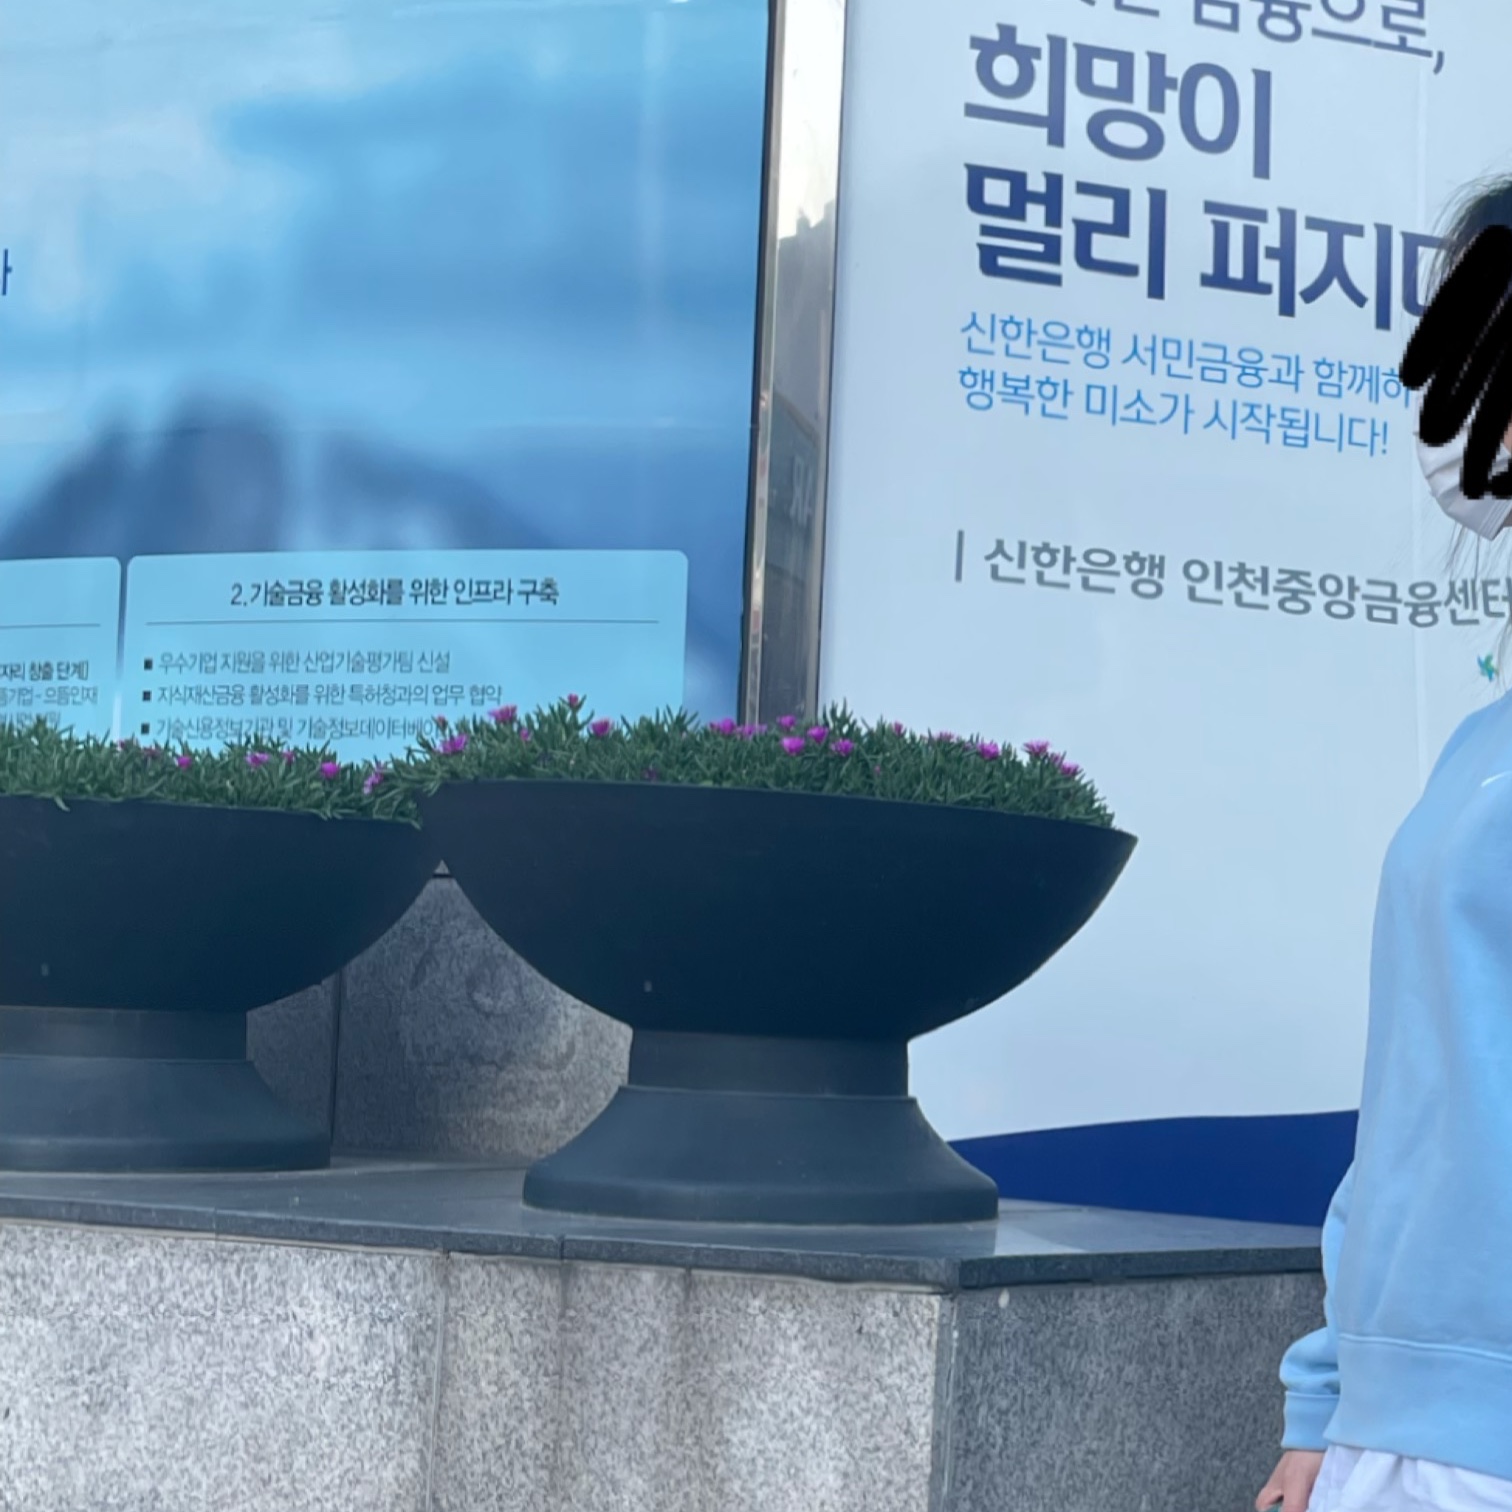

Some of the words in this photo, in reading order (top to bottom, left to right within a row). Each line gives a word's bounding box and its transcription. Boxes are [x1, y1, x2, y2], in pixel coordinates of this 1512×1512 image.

[964, 22, 1271, 180] 희망이
[963, 162, 1167, 300] 멀리
[960, 311, 1111, 370] 신한은행
[1121, 334, 1305, 393] 서민금융과
[958, 366, 1075, 420] 행복한
[1084, 383, 1195, 436] 미소가
[1202, 398, 1388, 457] 시작됩니다!
[229, 579, 324, 608] 2.기술금융
[327, 577, 405, 606] 활성화를
[408, 577, 449, 606] 위한
[453, 576, 514, 605] 인프라
[517, 576, 560, 606] 구축
[984, 538, 1166, 600] 신한은행
[157, 683, 245, 707] 지식재산금융
[249, 683, 310, 706] 활성화를
[313, 683, 346, 706] 위한
[347, 683, 429, 707] 특허청과의
[431, 683, 466, 707] 업무
[158, 650, 218, 675] 우수기업
[220, 650, 266, 674] 지원을
[268, 650, 300, 674] 위한
[416, 650, 450, 674] 신설
